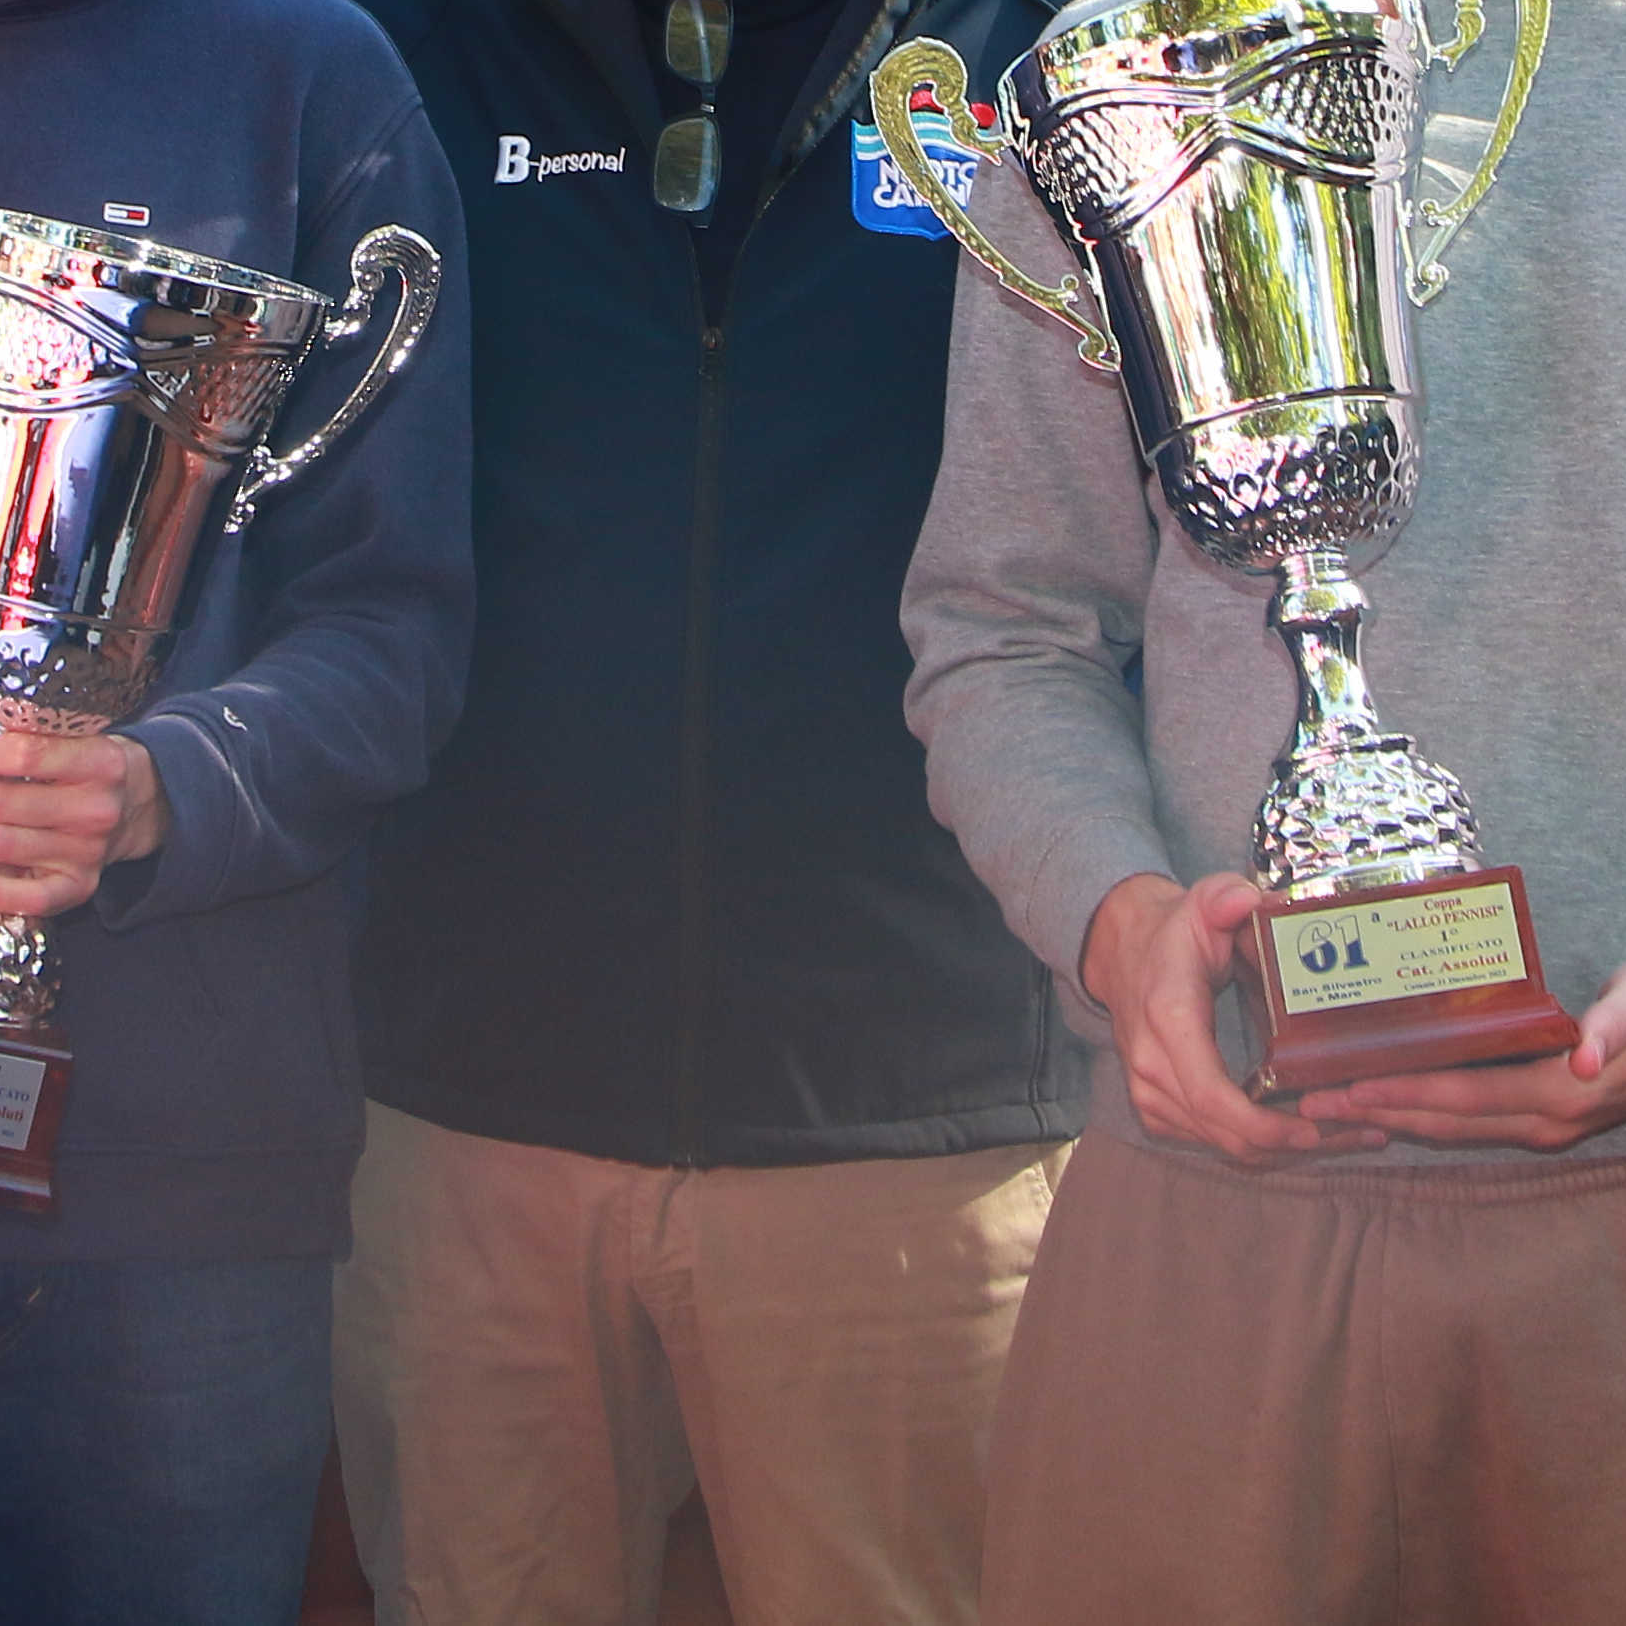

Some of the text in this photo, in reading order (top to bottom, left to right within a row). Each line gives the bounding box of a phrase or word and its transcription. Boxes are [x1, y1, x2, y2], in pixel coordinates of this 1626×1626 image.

[1423, 897, 1463, 912] Coppa
[1297, 915, 1369, 974] 61
[1400, 937, 1504, 961] CLASSIFICATO
[1396, 951, 1510, 979] Cat. Assoluti
